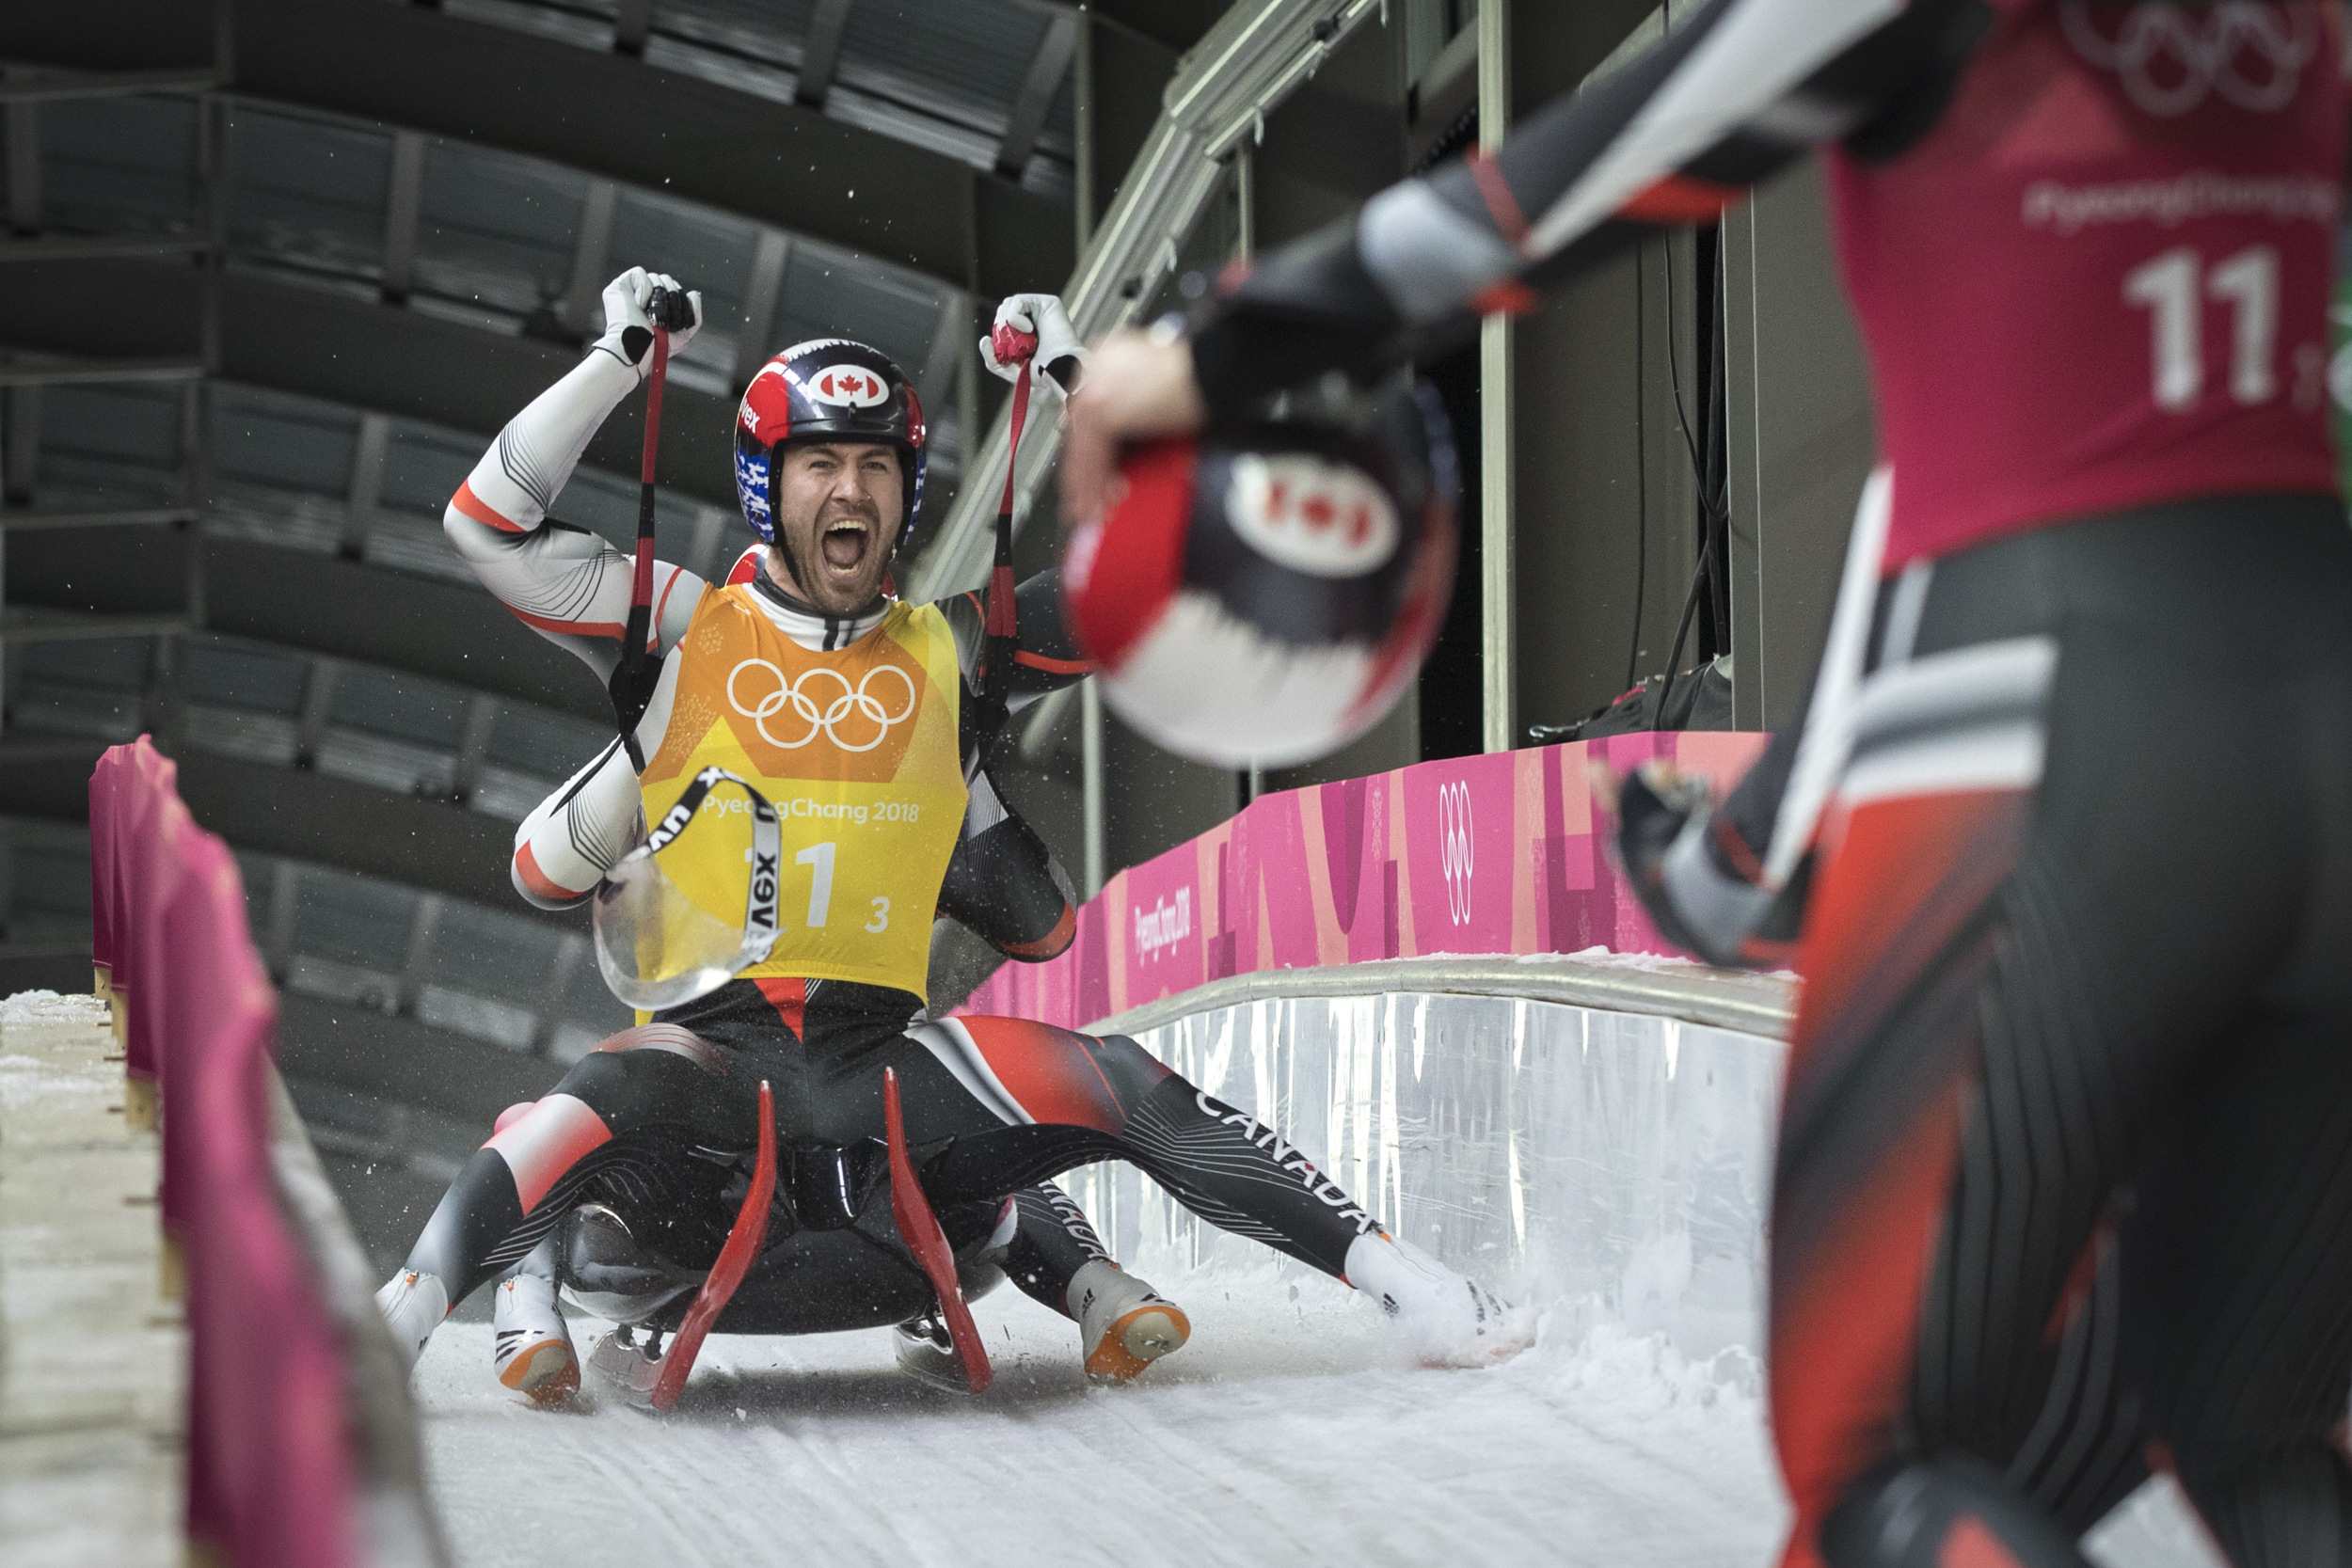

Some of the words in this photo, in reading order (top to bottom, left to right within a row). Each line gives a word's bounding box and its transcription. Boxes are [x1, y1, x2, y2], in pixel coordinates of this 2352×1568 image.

[2123, 245, 2280, 411] 11
[740, 397, 760, 434] vex
[702, 795, 868, 824] PyeogChang
[873, 801, 919, 823] 2018
[865, 896, 890, 933] 3
[1196, 1091, 1378, 1235] CANADA
